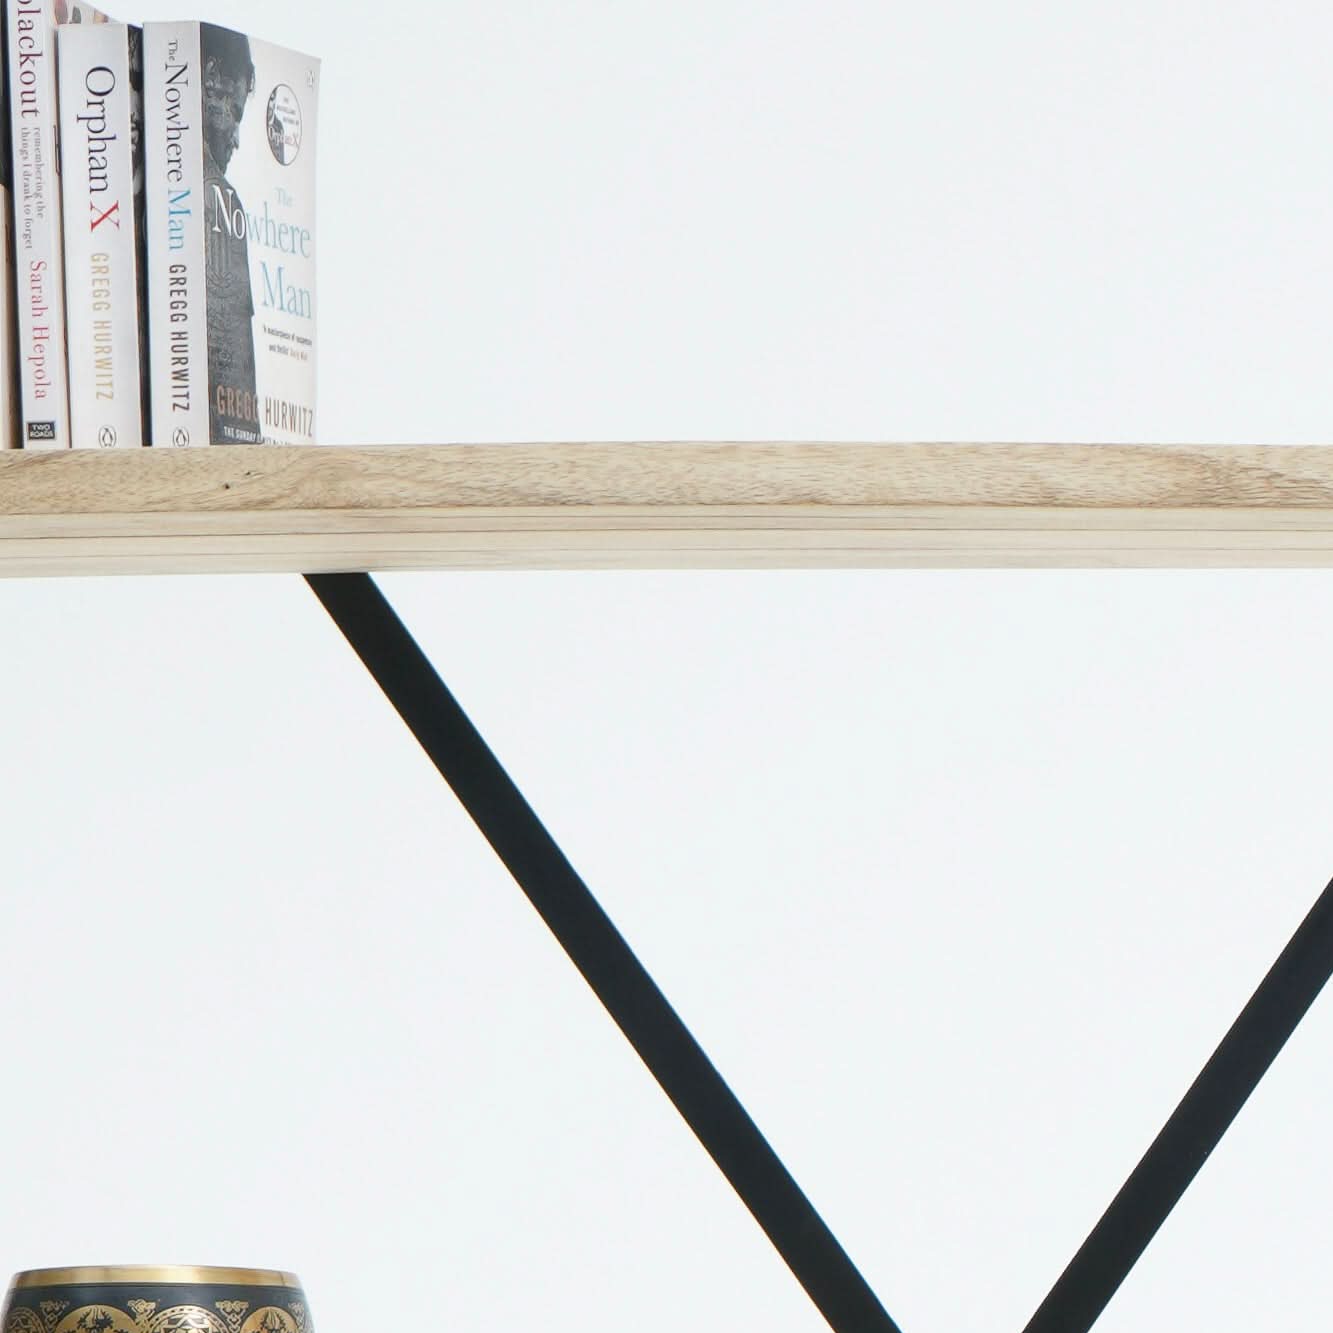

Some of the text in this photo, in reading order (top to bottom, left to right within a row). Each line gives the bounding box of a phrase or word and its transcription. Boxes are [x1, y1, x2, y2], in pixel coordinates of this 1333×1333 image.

[23, 170, 33, 201] drank
[33, 127, 47, 219] remembering the
[76, 66, 120, 232] Orphan X
[165, 39, 191, 250] The Nowhere Man
[22, 217, 33, 249] forget
[212, 184, 311, 258] Nowhere
[274, 187, 293, 208] The
[28, 260, 51, 399] Sarah Hepola
[90, 252, 114, 400] GREGG HURWITZ
[260, 261, 312, 319] Man
[169, 264, 190, 412] GREGG HURWITZ
[265, 396, 314, 437] HURWITZ
